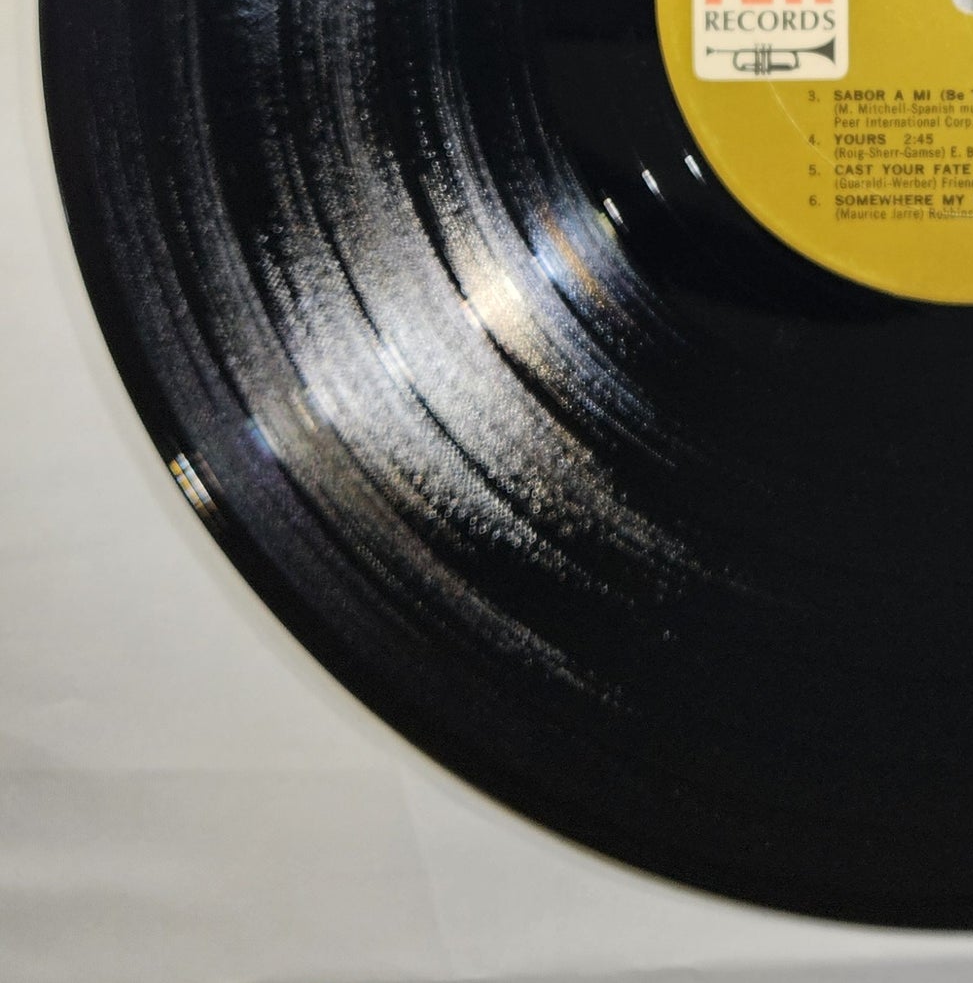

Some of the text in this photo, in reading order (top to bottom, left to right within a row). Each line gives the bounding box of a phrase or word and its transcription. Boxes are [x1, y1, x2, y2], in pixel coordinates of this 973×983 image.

[704, 10, 836, 31] RECORDS
[808, 90, 820, 102] 3.
[834, 89, 885, 102] SABOR
[894, 89, 903, 102] A
[913, 89, 930, 101] MI
[940, 89, 964, 101] (Be
[834, 103, 852, 116] (M.
[859, 103, 954, 115] Mitchell-Spanish
[834, 117, 859, 129] Peer
[866, 117, 940, 129] International
[808, 133, 933, 146] 4. YOURS 2:45
[835, 147, 945, 159] (Roig-Sherr-Gamse)
[951, 146, 961, 159] E.
[808, 164, 820, 176] 5.
[835, 164, 872, 176] CAST
[882, 163, 924, 176] YOUR
[934, 163, 971, 176] FATE
[835, 177, 937, 189] (Guaraldi-Werber)
[808, 195, 820, 207] 6.
[835, 194, 933, 206] SOMEWHERE
[942, 194, 964, 206] MY
[835, 208, 886, 220] (Maurice
[892, 208, 924, 220] Jarre)
